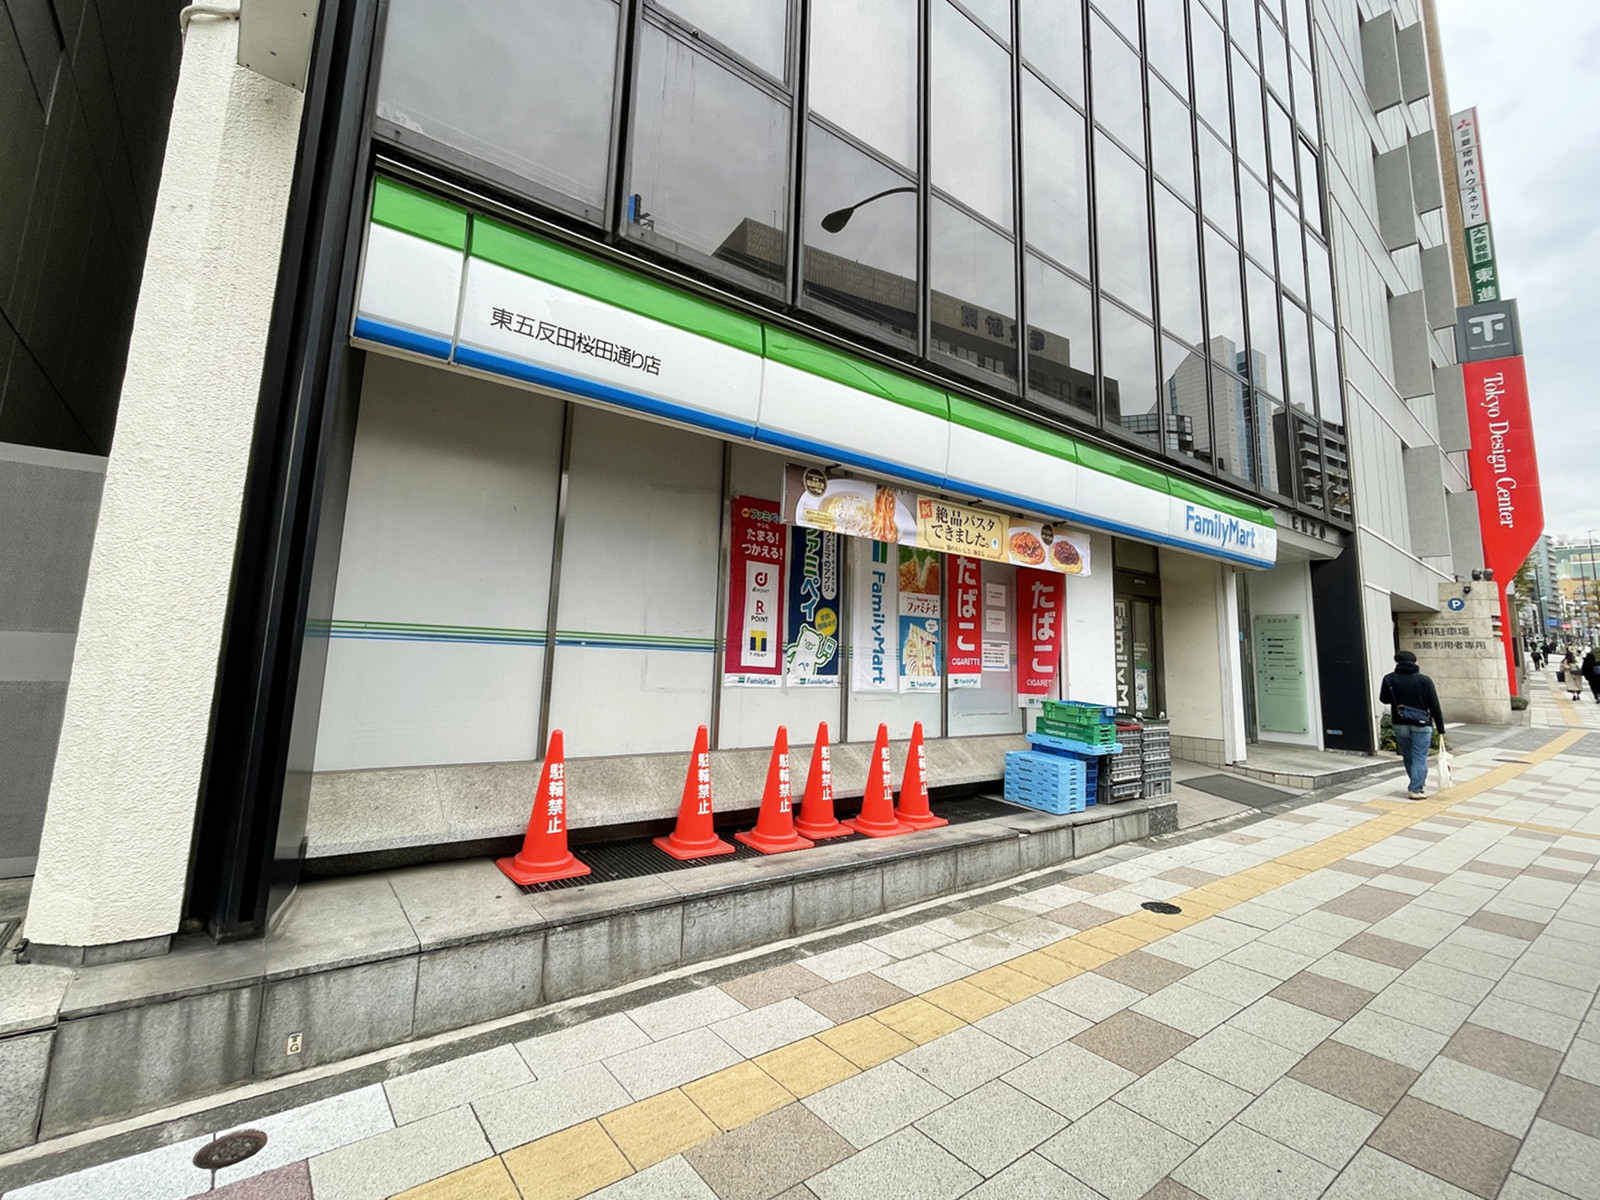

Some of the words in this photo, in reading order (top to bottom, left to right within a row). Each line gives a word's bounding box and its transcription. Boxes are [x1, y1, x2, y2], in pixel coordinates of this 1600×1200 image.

[1475, 267, 1497, 302] 東進
[490, 306, 661, 376] 東五反田桜田通り店
[1480, 372, 1505, 418] Tokyo
[1486, 420, 1511, 474] Design
[750, 508, 780, 523] ファミペ
[935, 505, 995, 532] 絶品パスタ
[1496, 477, 1517, 528] Center
[746, 528, 780, 545] たまる!
[931, 523, 990, 549] できました。
[1186, 504, 1256, 549] FamilyMart
[741, 543, 783, 560] つかえる!
[755, 600, 765, 613] R
[907, 602, 938, 615] ファミチキ
[956, 556, 978, 651] たばこ
[871, 570, 886, 684] FamilyMart
[1031, 581, 1056, 673] たばこ
[1413, 627, 1470, 637] 有料駐車場
[951, 657, 981, 666] CIGARETTE
[697, 753, 711, 815] 駐輪禁止
[778, 754, 790, 813] 駐輪禁止
[820, 746, 832, 801] 駐輪禁止
[881, 747, 893, 800] 駐輪禁止
[546, 763, 565, 834] 駐輪禁止
